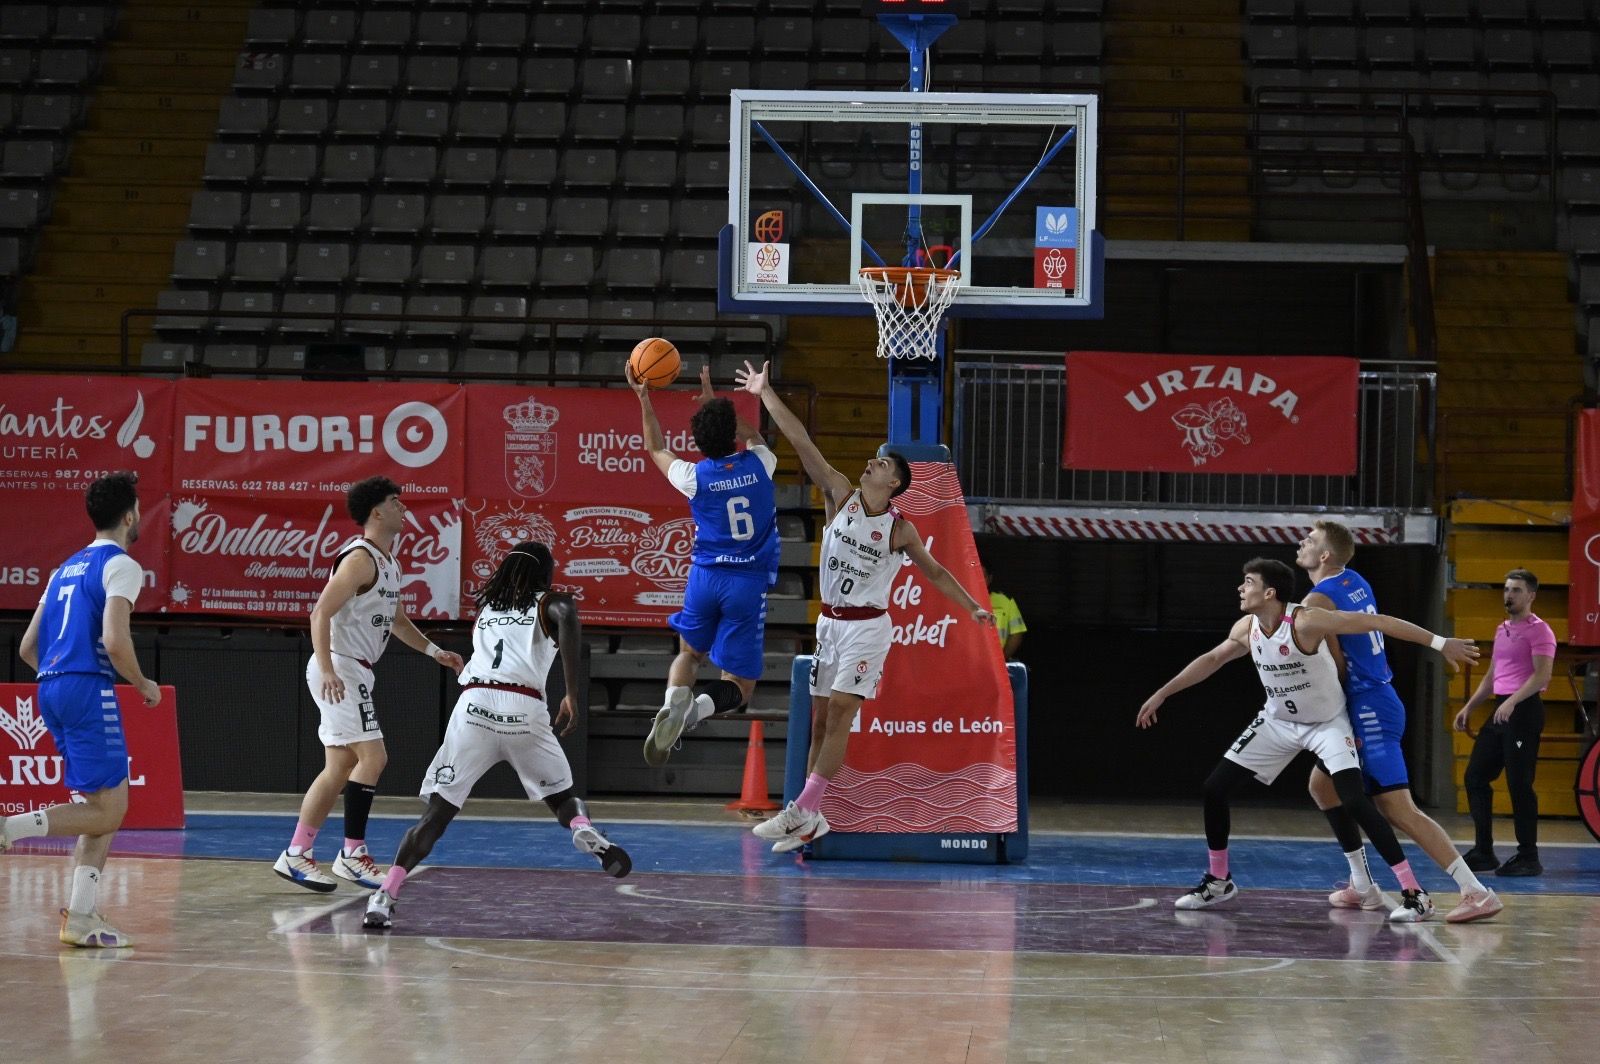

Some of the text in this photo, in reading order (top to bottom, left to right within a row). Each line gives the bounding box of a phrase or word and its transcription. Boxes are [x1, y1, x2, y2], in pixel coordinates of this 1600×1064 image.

[1124, 365, 1300, 420] URZAPA
[0, 397, 112, 440] antes
[184, 414, 374, 453] FUROR!
[578, 447, 645, 472] de león
[55, 470, 80, 479] 987
[709, 473, 759, 492] CORRALIZA
[43, 482, 56, 490] 10
[66, 481, 90, 490] LEÓ
[182, 479, 238, 491] RESERVAS:
[241, 481, 262, 491] 622
[266, 481, 285, 491] 788
[289, 482, 308, 491] 427
[619, 509, 643, 519] ESTILO
[726, 496, 755, 541] 6
[569, 526, 639, 548] Brillar
[858, 543, 882, 559] RURAL
[260, 590, 266, 599] 3
[272, 589, 295, 600] 24191
[840, 578, 855, 595] 0
[892, 574, 922, 610] de
[57, 584, 76, 640] 7
[201, 600, 246, 610] Teléfonos:
[265, 602, 276, 611] 97
[890, 614, 958, 648] asket
[491, 638, 504, 670] 1
[1262, 661, 1305, 671] CAJA RURAL
[358, 683, 370, 700] 8
[1274, 681, 1311, 694] E.Leclerc
[1284, 699, 1298, 715] 9
[868, 715, 1003, 737] Aguas de León
[941, 838, 988, 849] MONDO
